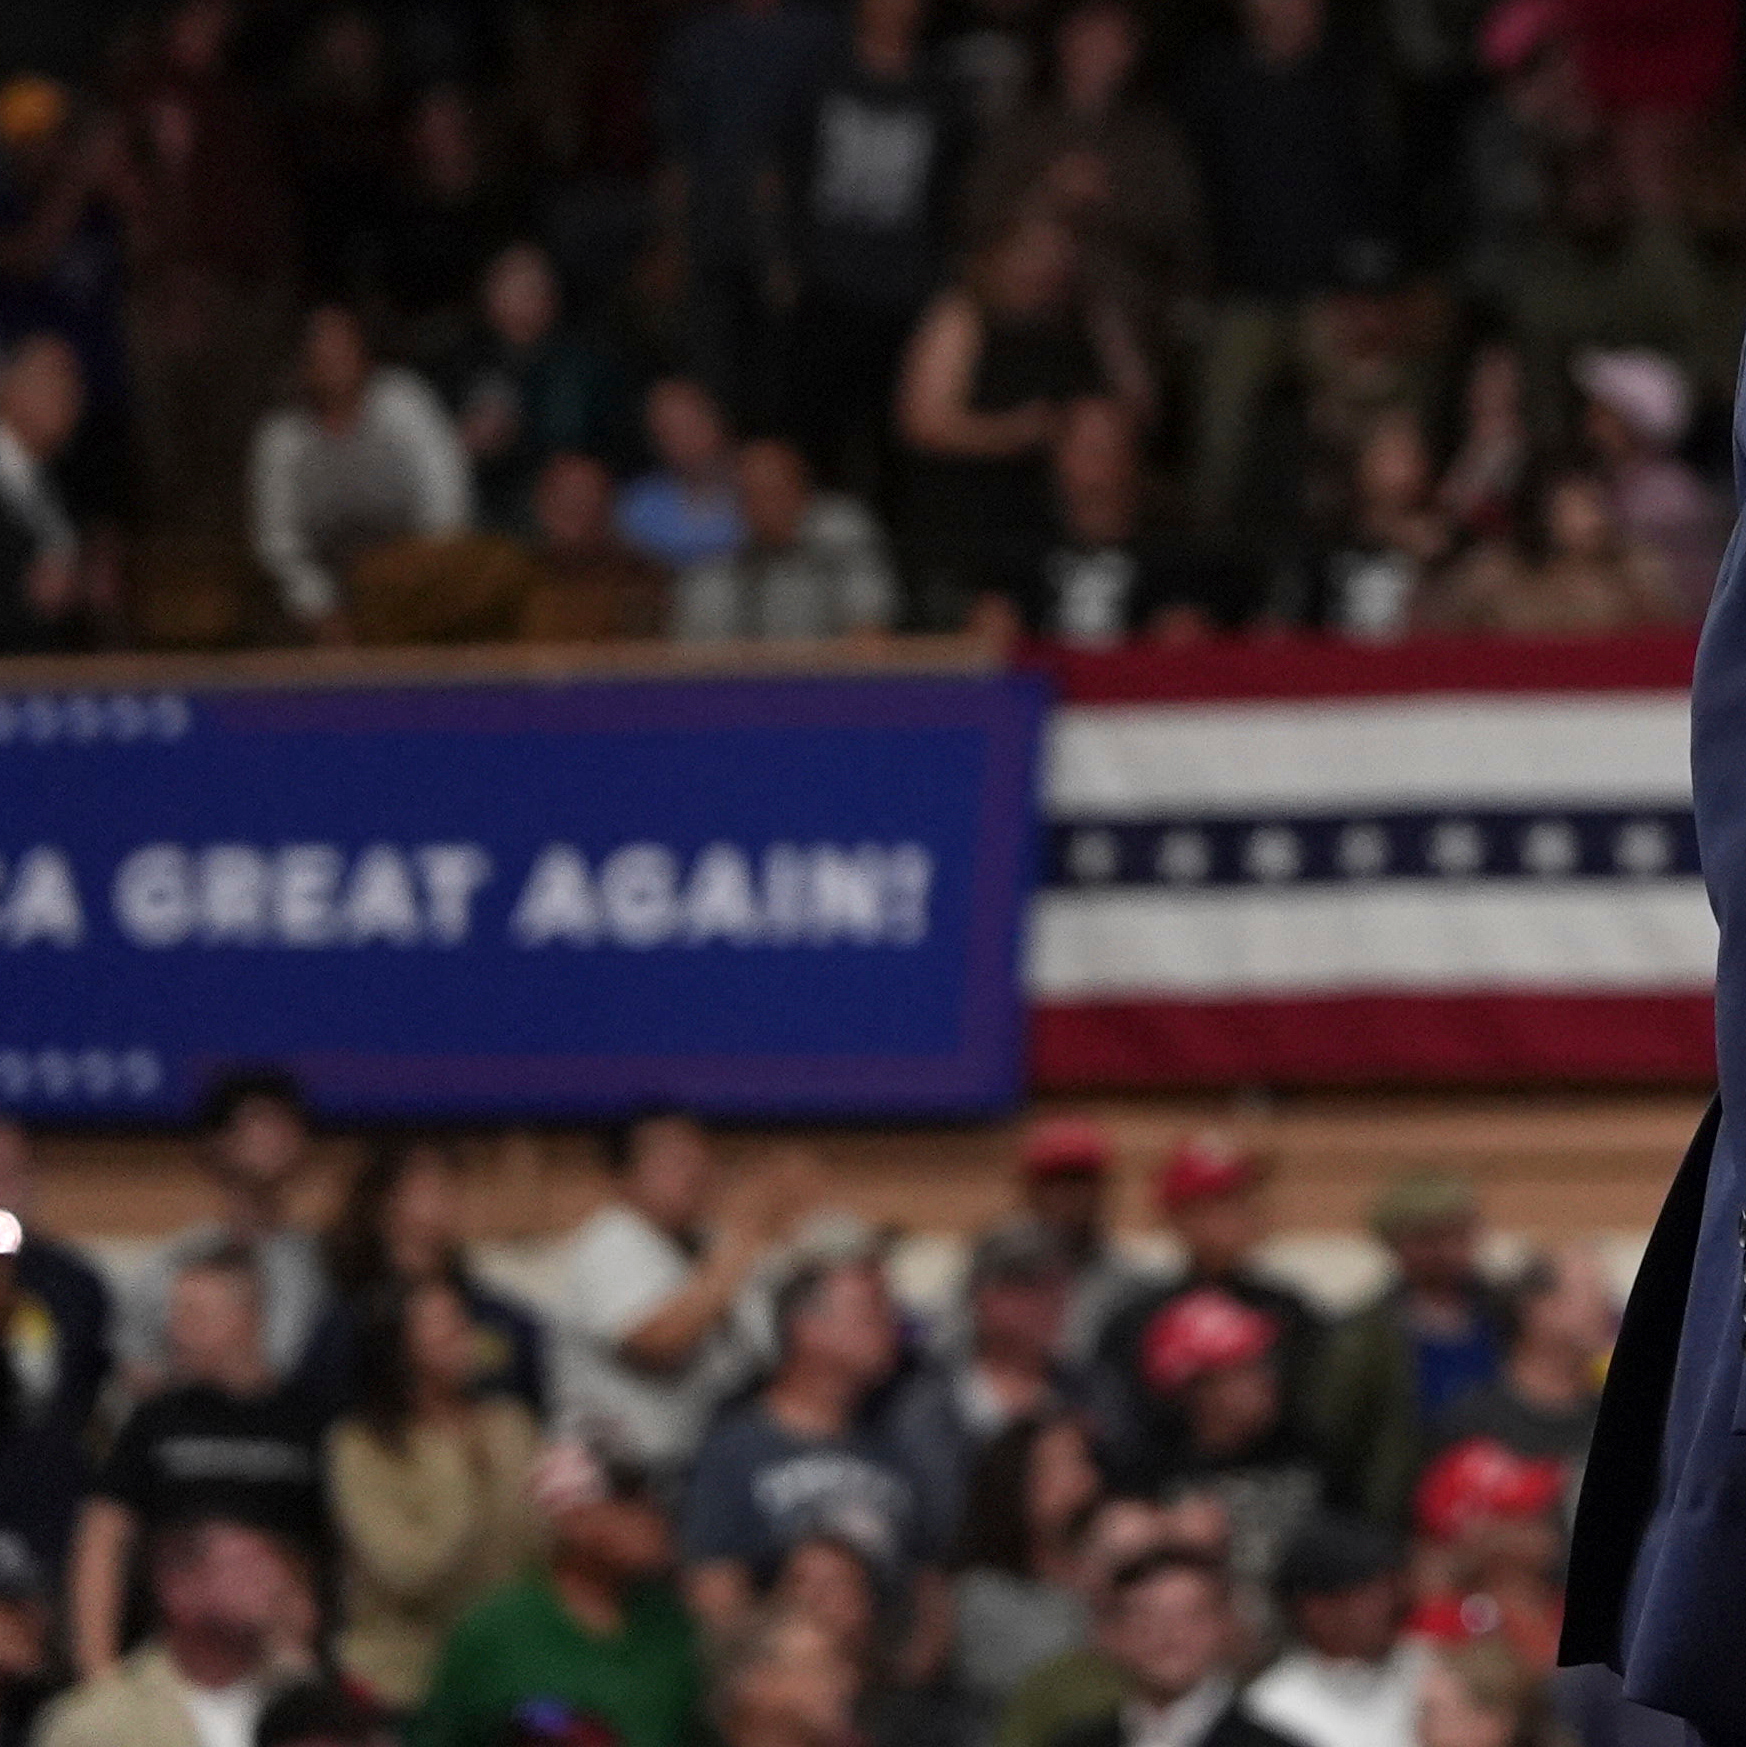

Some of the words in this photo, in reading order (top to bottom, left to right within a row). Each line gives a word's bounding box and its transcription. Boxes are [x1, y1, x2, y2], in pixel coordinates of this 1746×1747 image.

[0, 844, 86, 950] A
[110, 841, 490, 949] GREAT
[512, 841, 934, 948] AGAIN!
